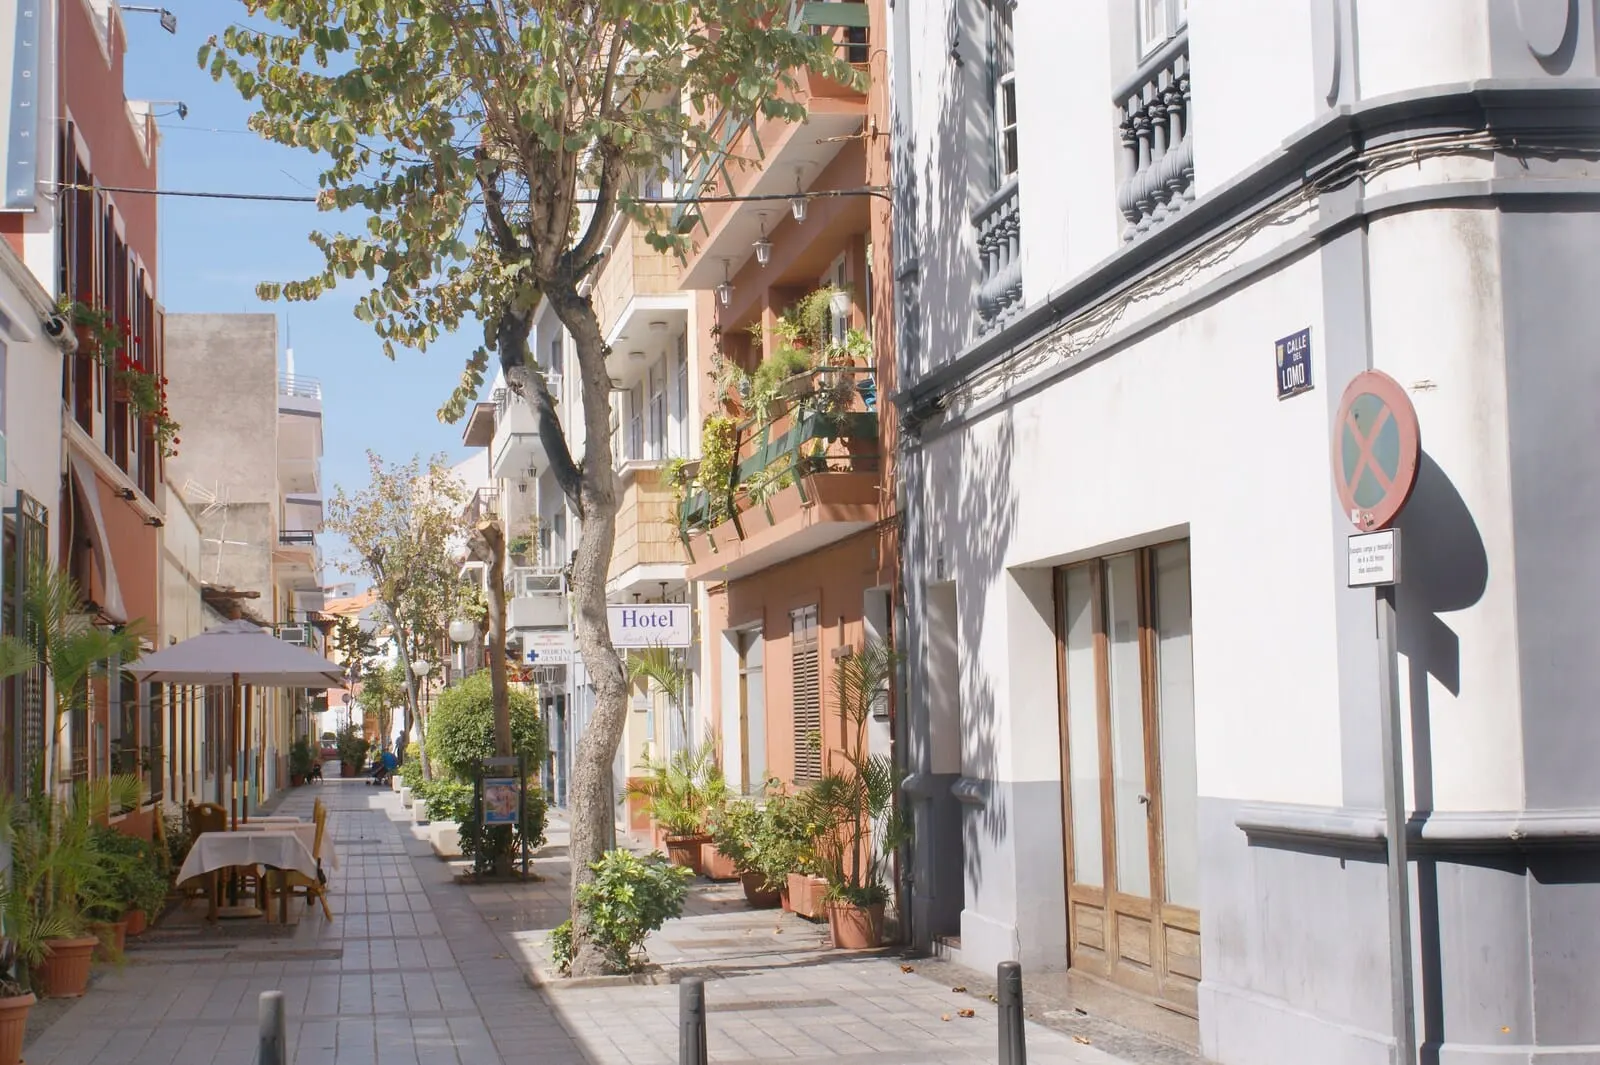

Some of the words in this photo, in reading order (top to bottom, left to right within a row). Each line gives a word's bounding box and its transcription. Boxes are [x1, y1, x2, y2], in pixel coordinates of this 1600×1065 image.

[1286, 334, 1307, 354] CALLE
[1292, 352, 1302, 361] DEL
[1282, 363, 1305, 390] LOMO
[622, 610, 674, 627] Hotel
